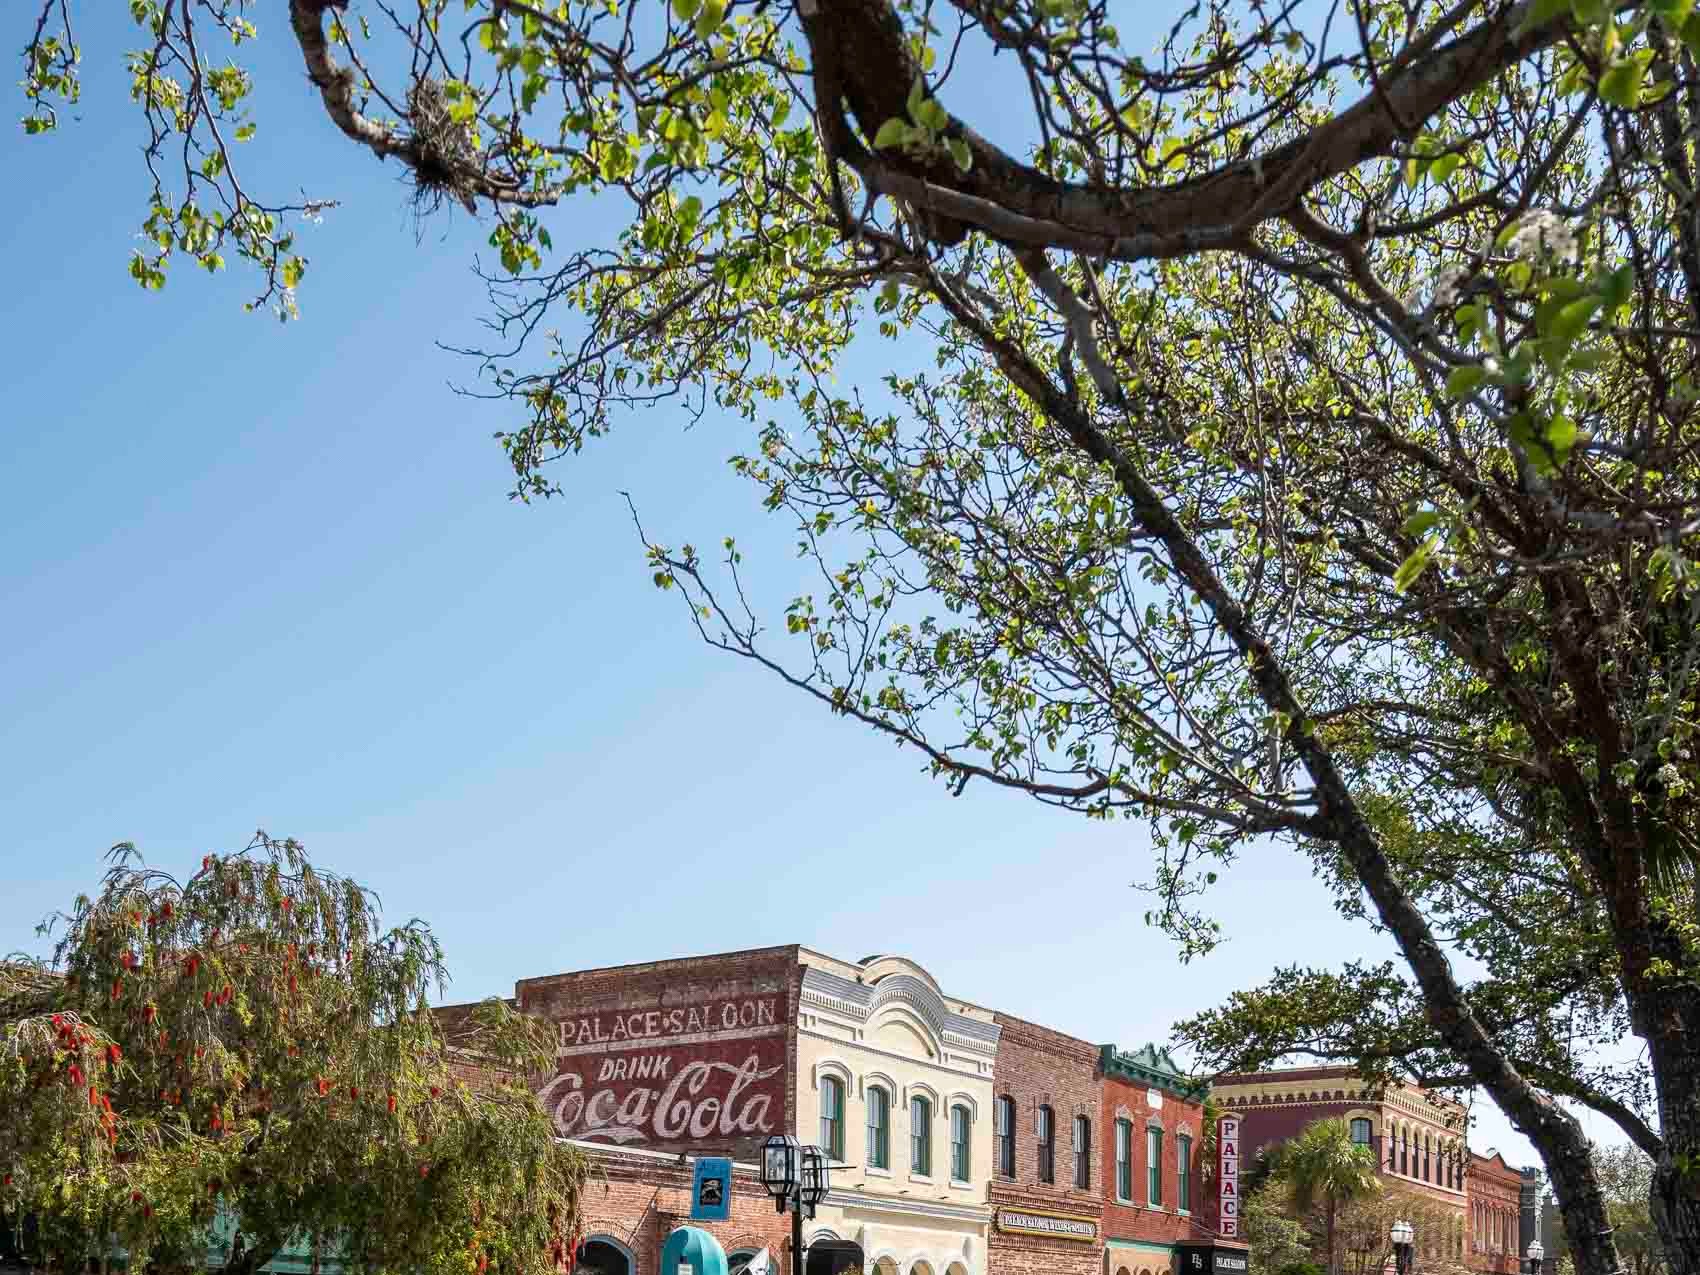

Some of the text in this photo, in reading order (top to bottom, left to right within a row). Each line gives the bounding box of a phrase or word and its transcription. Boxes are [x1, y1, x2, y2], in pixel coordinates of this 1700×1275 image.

[560, 999, 776, 1047] PALACE SALOON
[599, 1055, 672, 1081] DRINK
[1223, 1122, 1236, 1235] PALACE
